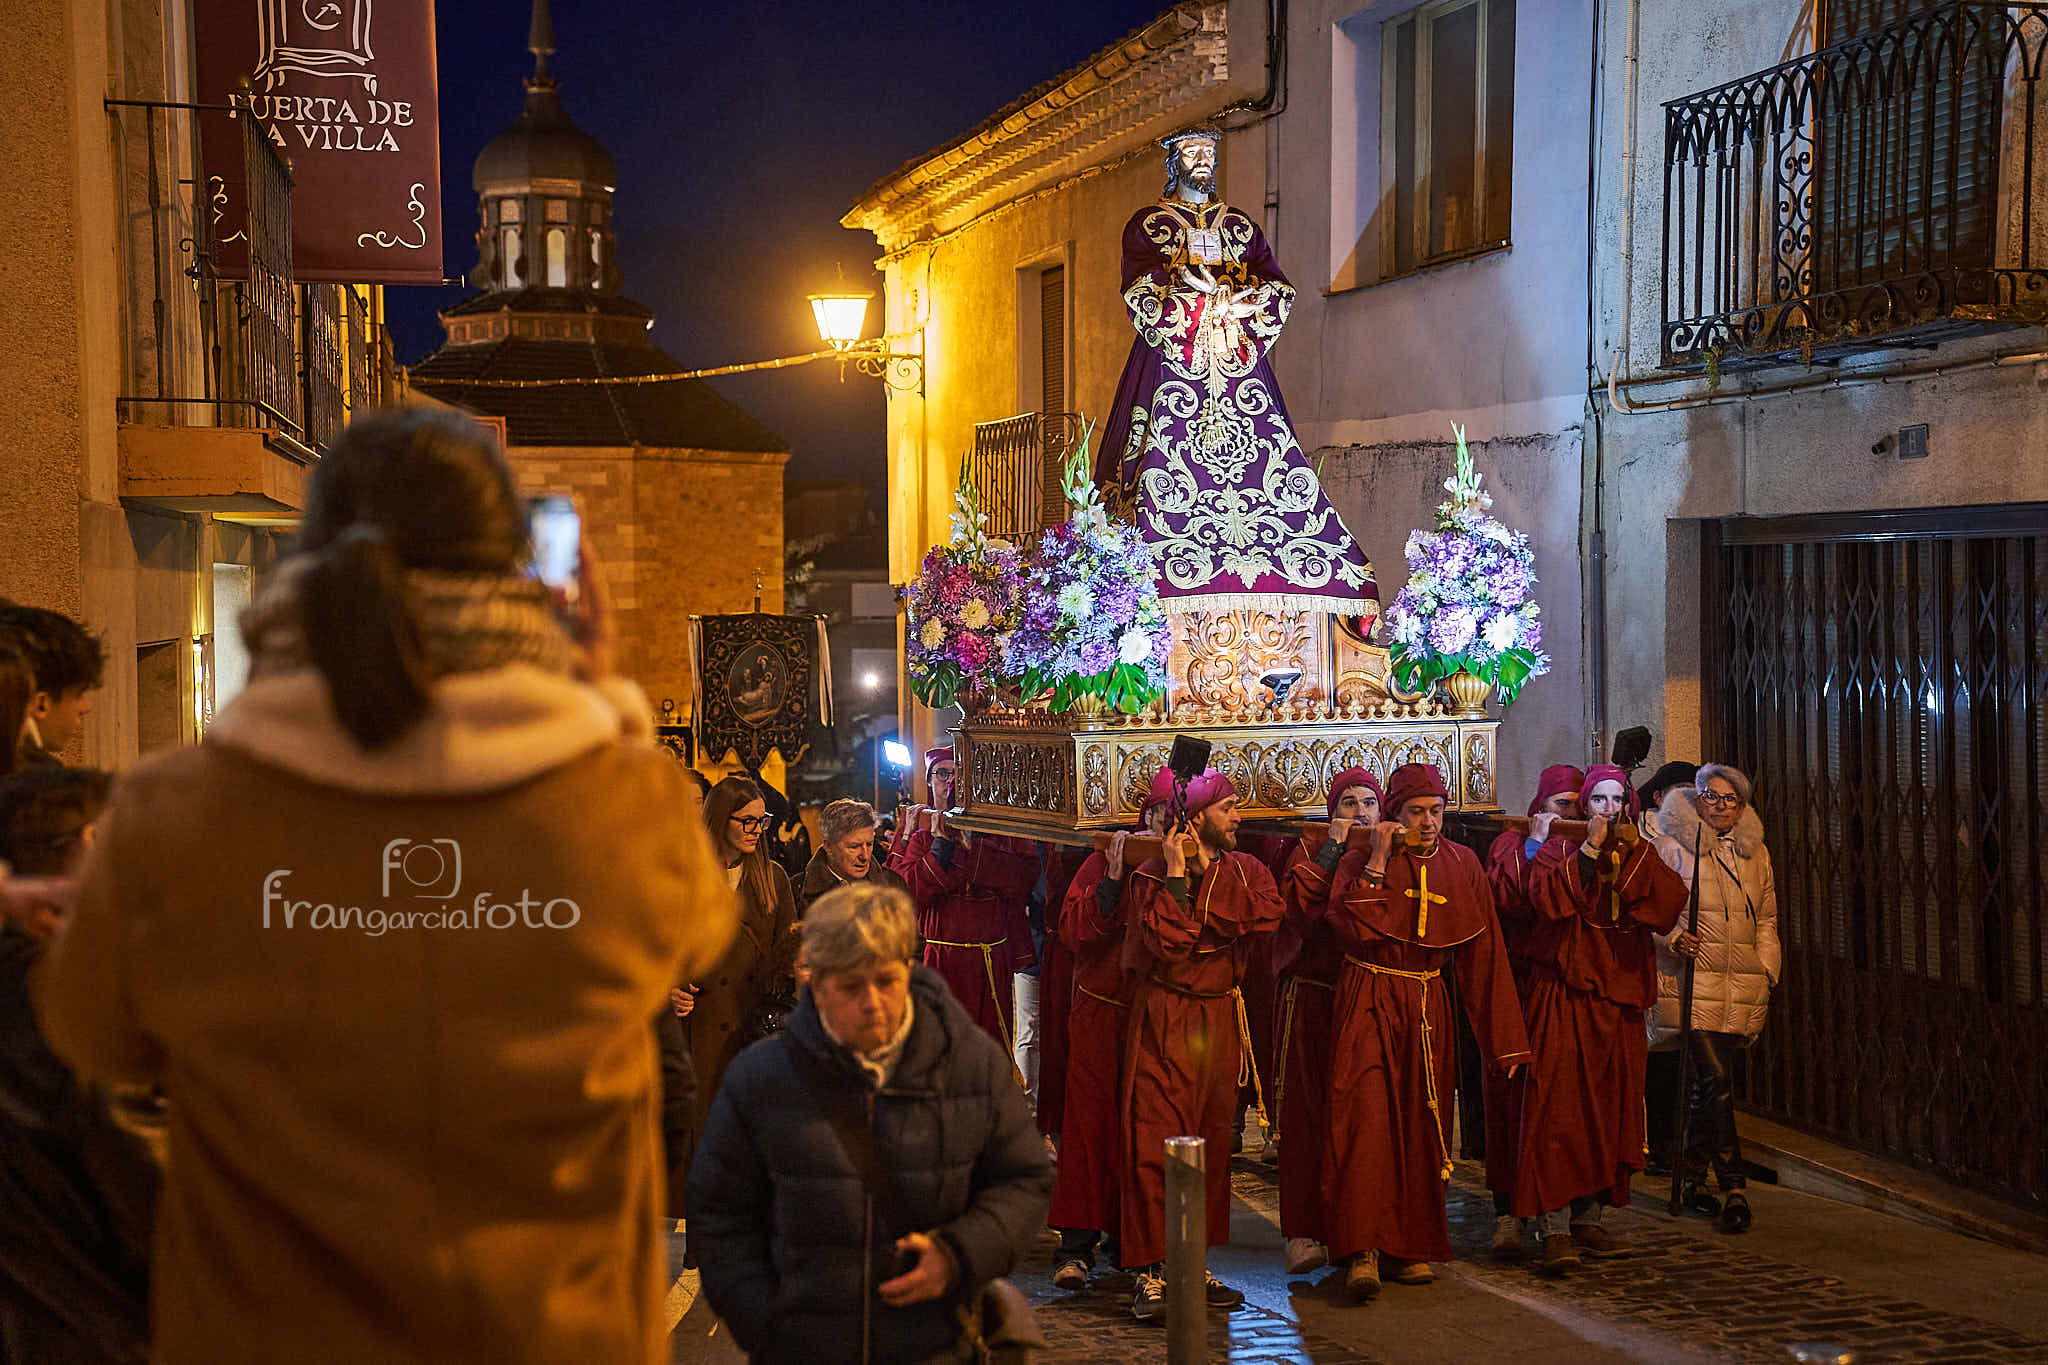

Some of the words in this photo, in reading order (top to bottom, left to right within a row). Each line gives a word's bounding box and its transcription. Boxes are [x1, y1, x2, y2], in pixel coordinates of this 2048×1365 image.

[367, 99, 414, 126] DE
[267, 123, 288, 147] A
[295, 124, 400, 152] VILLA
